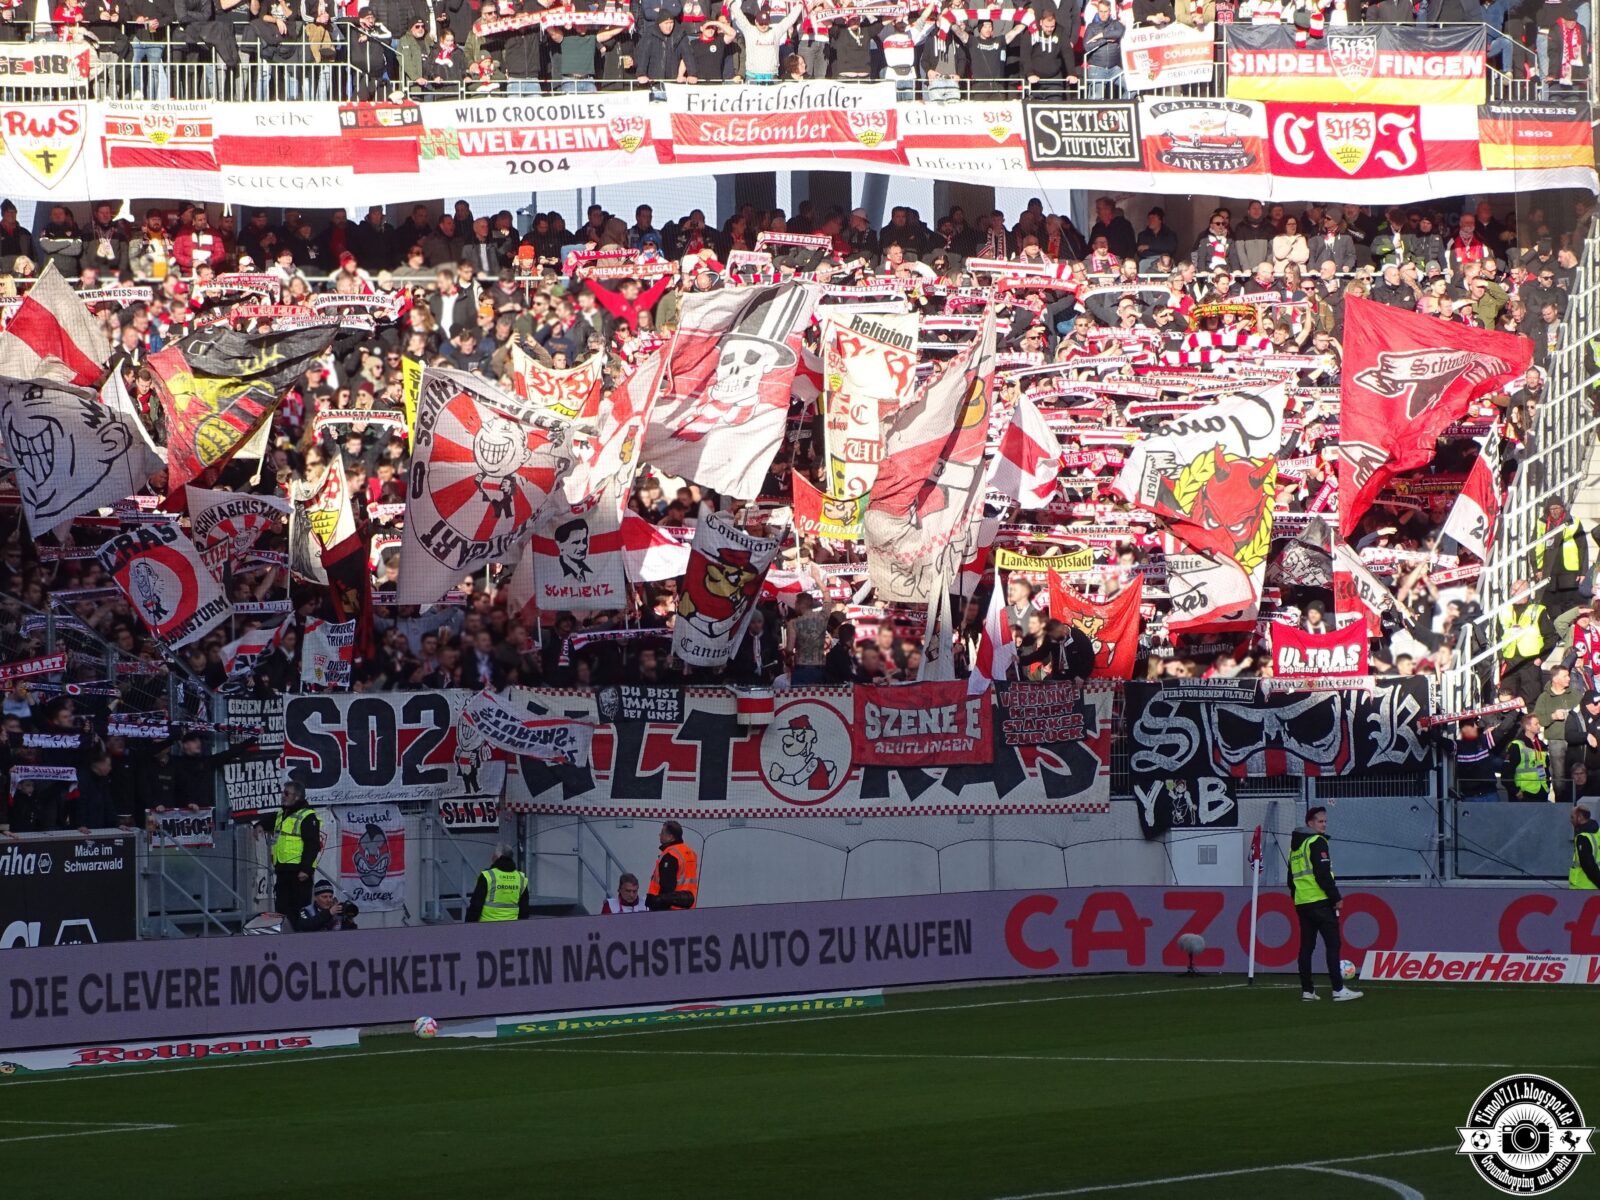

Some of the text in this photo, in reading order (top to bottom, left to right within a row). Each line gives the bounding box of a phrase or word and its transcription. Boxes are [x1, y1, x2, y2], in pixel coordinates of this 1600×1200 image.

[1230, 54, 1332, 75] SINDEL
[1379, 54, 1483, 75] FINGEN
[686, 86, 863, 113] Friedrichshaller
[1157, 101, 1242, 114] GALEERE
[455, 103, 606, 123] WILD CROCODILES
[905, 109, 973, 126] Glems
[1490, 105, 1577, 115] BROTHERS
[699, 115, 832, 143] Salzbomber
[458, 127, 609, 153] WELZHEIM
[505, 157, 571, 175] 2004
[915, 156, 992, 171] Inferno
[1161, 153, 1249, 171] CANNSTATT
[592, 266, 634, 276] NIEMALS
[1024, 278, 1049, 287] White
[105, 287, 132, 299] WEISS
[850, 314, 914, 350] Religion
[1001, 551, 1093, 568] Landeshauptstadt
[1278, 644, 1361, 668] ULTRAS
[620, 685, 680, 699] DU BIST
[1207, 678, 1240, 688] ALLEN
[1000, 687, 1081, 708] VERBANNTE
[1163, 690, 1225, 699] VERSTORBENEN
[621, 698, 680, 711] IMMER
[623, 710, 680, 721] BEI UNS!
[864, 701, 958, 740] SZENE
[441, 800, 497, 825] SLN 15
[101, 844, 113, 856] im
[64, 859, 123, 874] Schwarzwald
[1004, 891, 1398, 970] CAZOO
[10, 918, 972, 1020] DIE CLEVERE MÖGLICHKEIT, DEIN NÄCHSTES AUTO ZU KAUFEN
[1372, 951, 1567, 984] WeberHaus
[515, 996, 866, 1034] Schwarzwaldmilch
[70, 1035, 313, 1066] Rothaus
